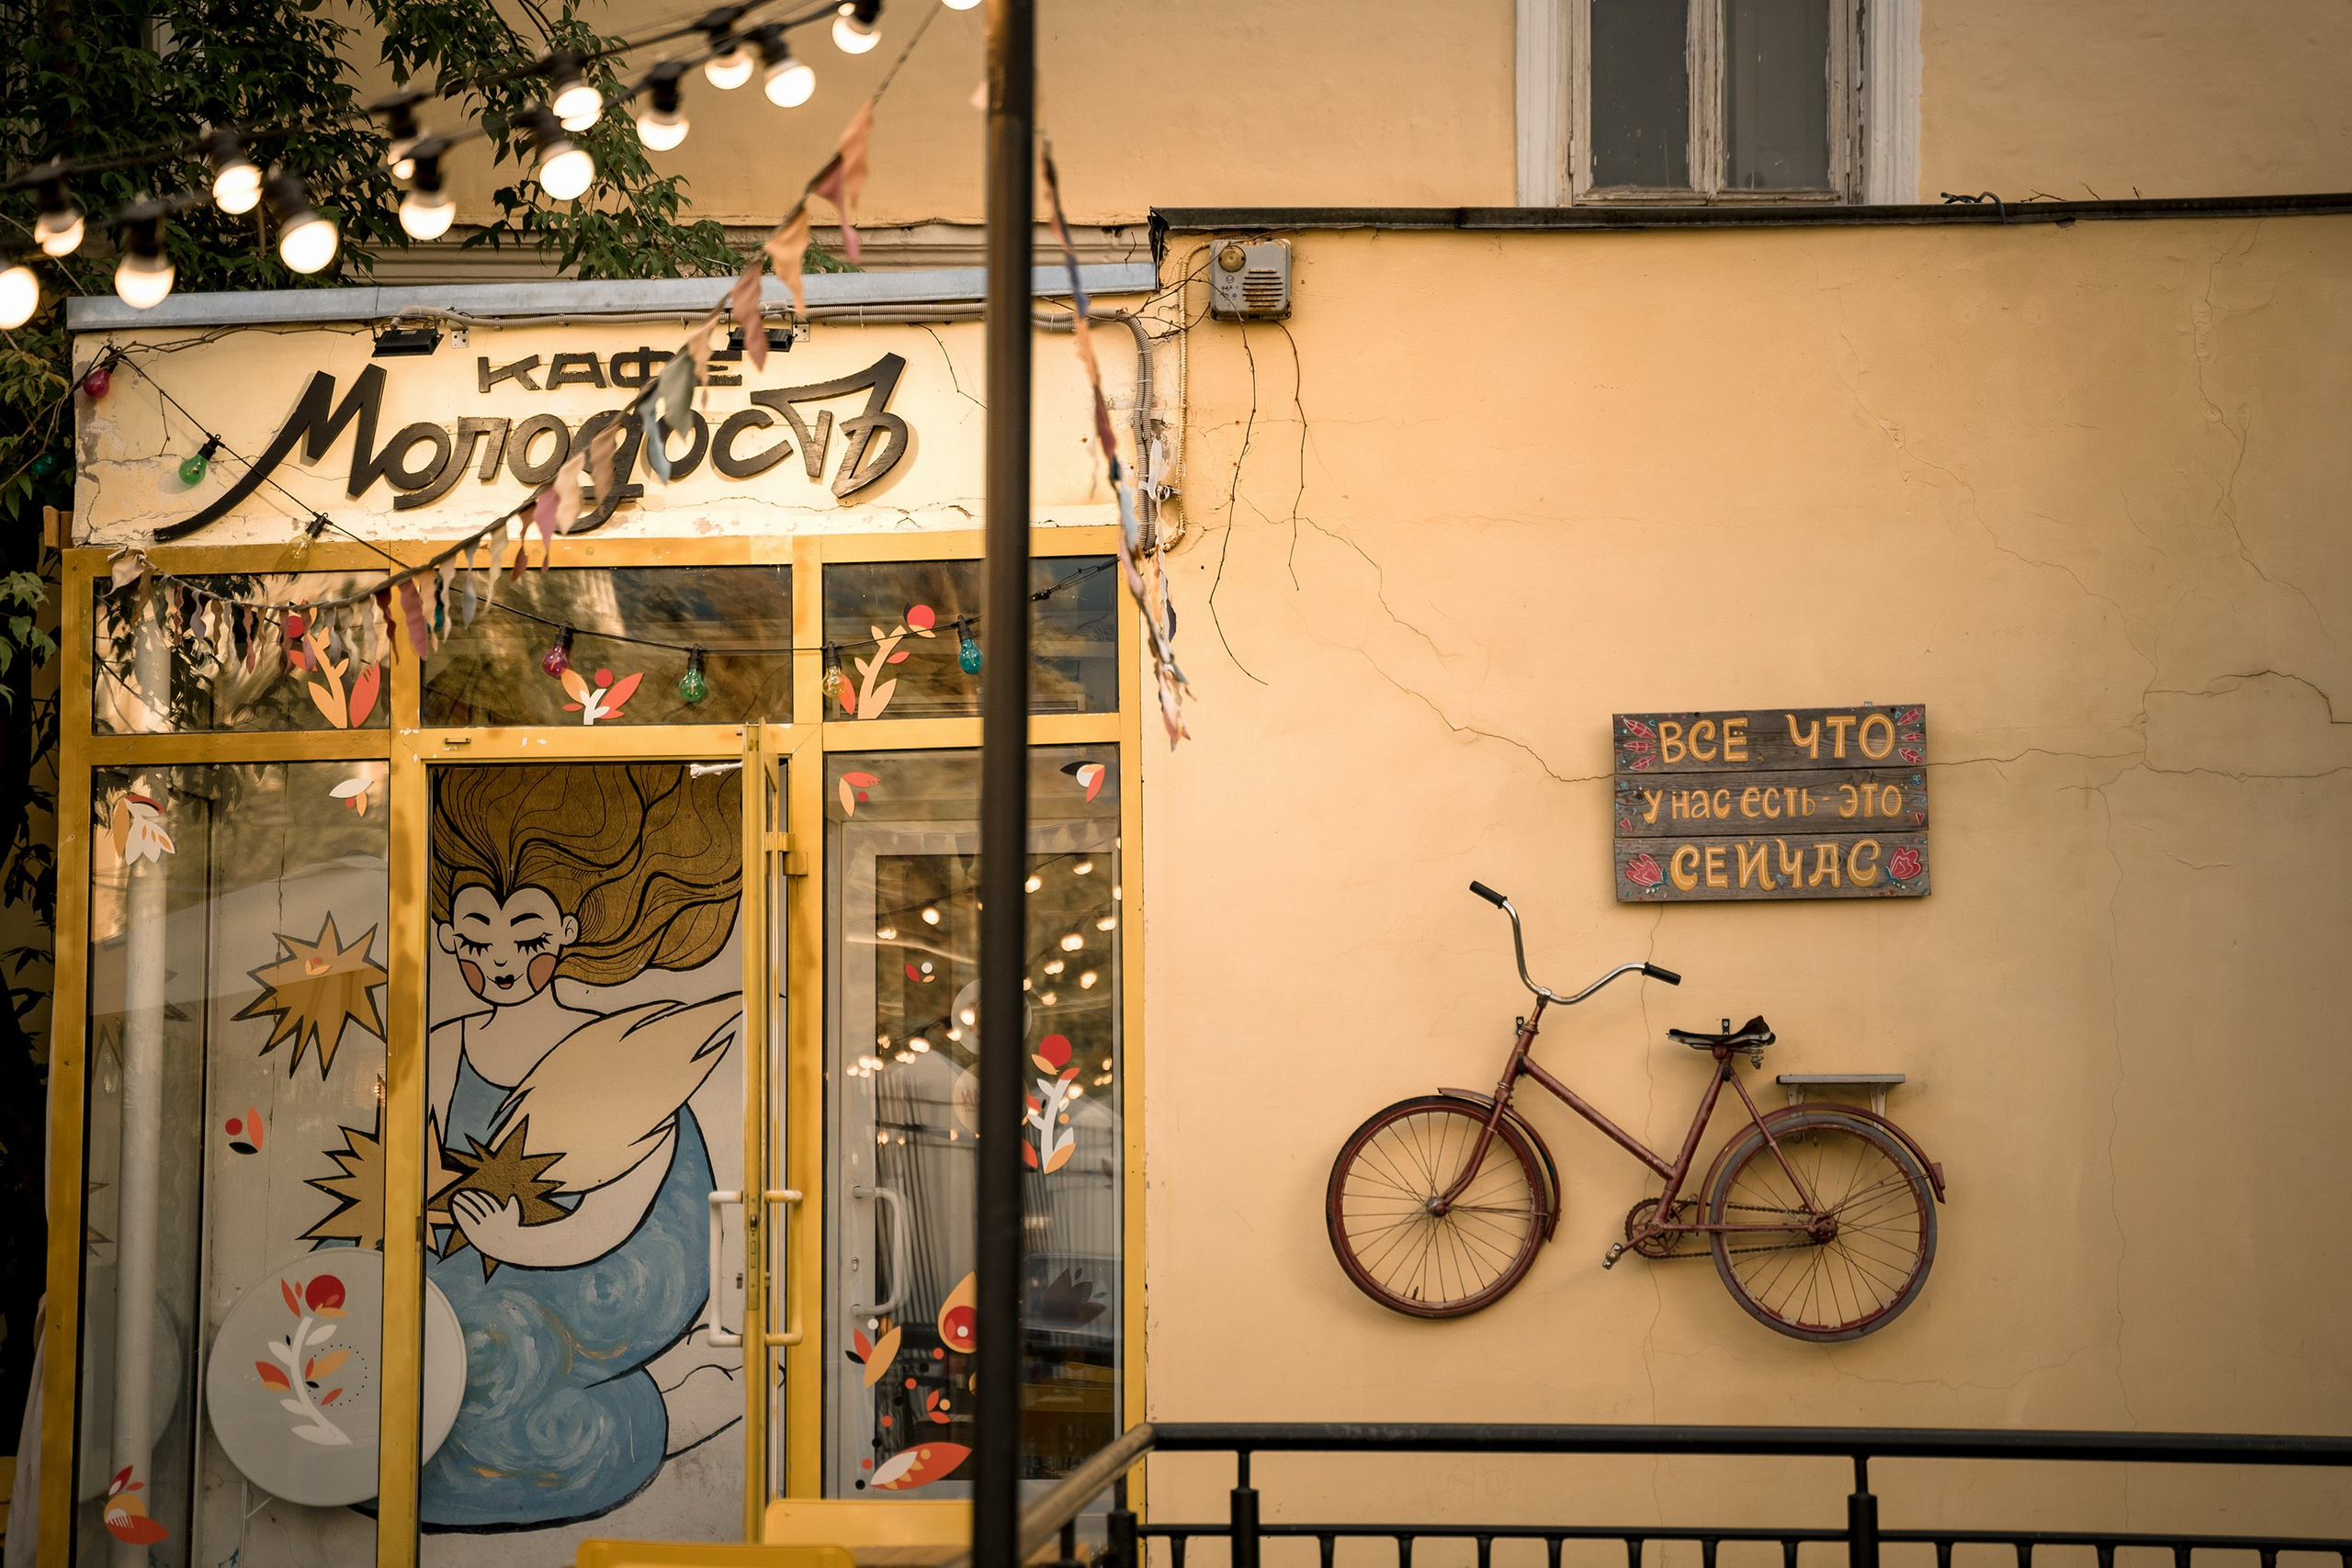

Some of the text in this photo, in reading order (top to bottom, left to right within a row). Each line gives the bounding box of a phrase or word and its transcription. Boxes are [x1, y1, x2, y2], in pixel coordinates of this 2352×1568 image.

[478, 346, 743, 393] КАФЕ
[1784, 713, 1896, 761] ЧТО
[1672, 789, 1732, 820] нас
[1740, 785, 1816, 819] есть
[1670, 838, 1883, 892] СЕЙЧАС
